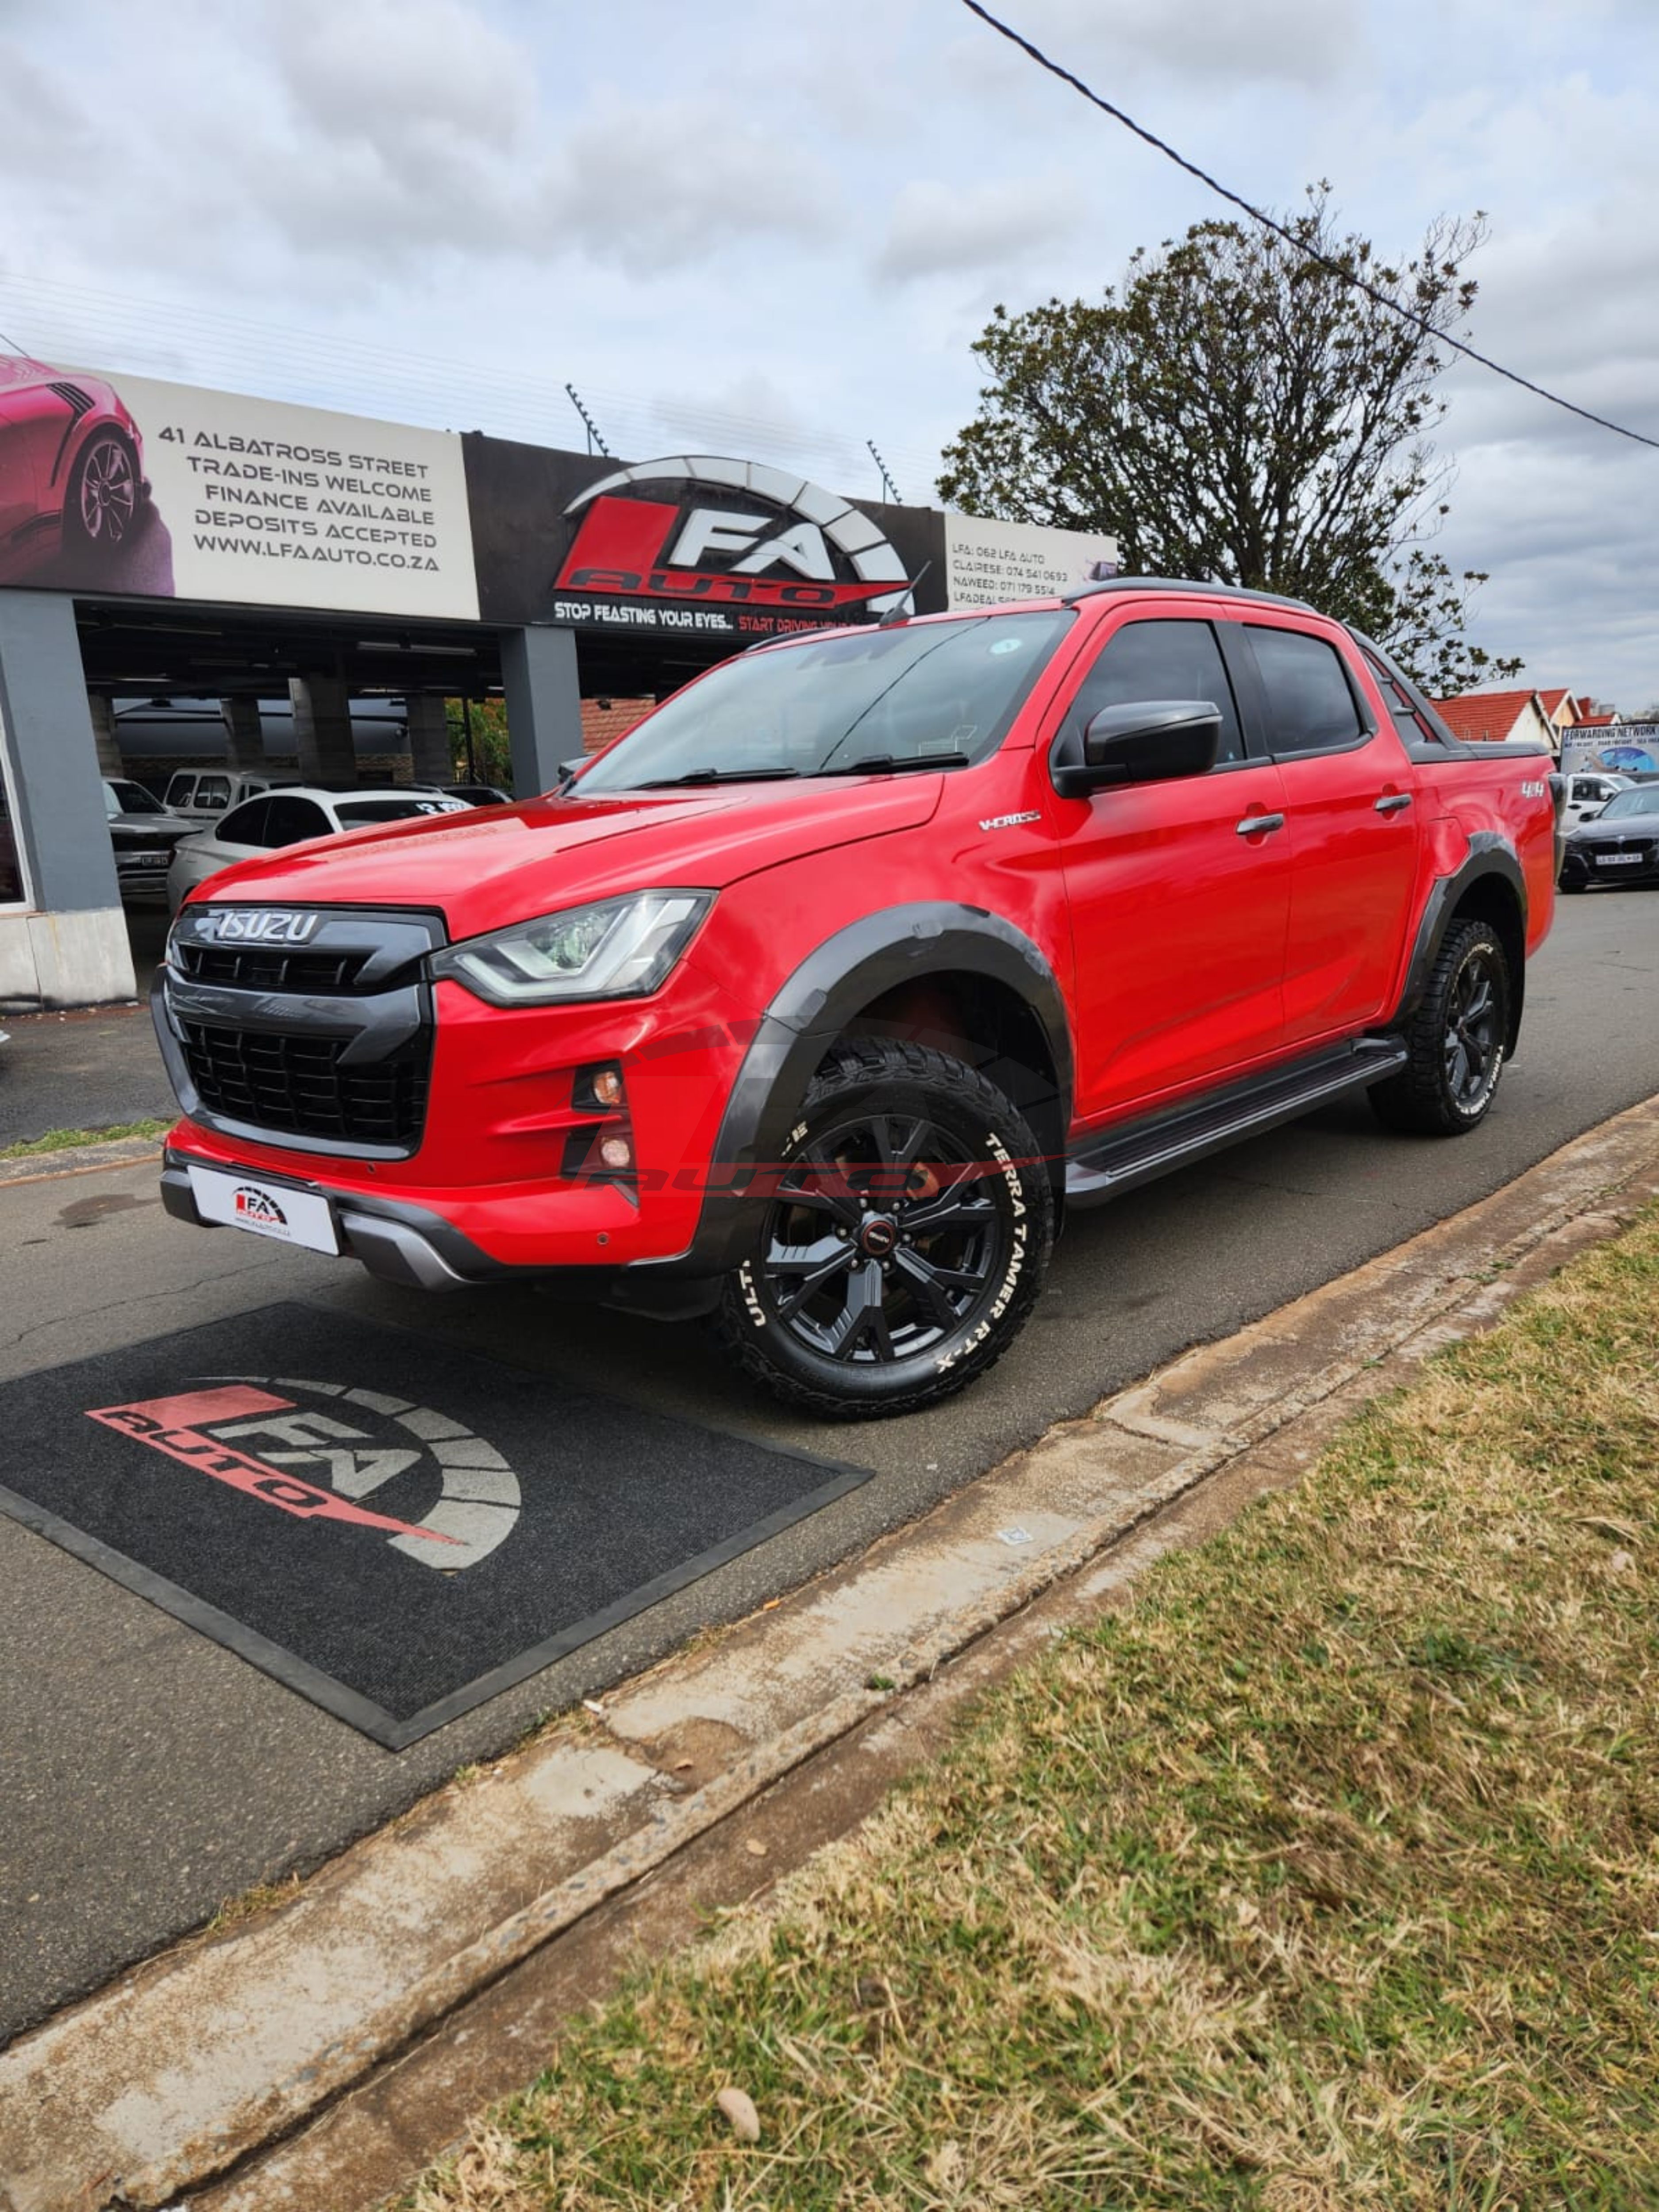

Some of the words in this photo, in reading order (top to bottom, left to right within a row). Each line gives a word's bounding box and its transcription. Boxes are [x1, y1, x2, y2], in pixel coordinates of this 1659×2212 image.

[158, 427, 185, 443] 41
[194, 431, 342, 466] ALBATROSS
[349, 455, 429, 479] STREET
[186, 456, 319, 488] TRADE-INS
[325, 475, 432, 502] WELCOME
[206, 485, 308, 511] FINANCE
[317, 499, 434, 525] AVAILABLE
[195, 509, 318, 536] DEPOSITS
[325, 524, 437, 548] ACCEPTED
[193, 535, 439, 572] WWW.LFAAUTO.CO.ZA
[1020, 553, 1045, 565] AUTO
[568, 568, 835, 604] AUTO
[554, 602, 591, 619] STOP
[593, 604, 656, 624] FEASTING
[658, 609, 693, 627] YOUR
[739, 616, 774, 631] START
[777, 619, 817, 633] DRIVING
[1617, 726, 1655, 737] NETWORK
[217, 913, 317, 941] ISUZU
[985, 1132, 1027, 1217] TERRA
[989, 1223, 1027, 1320] TAMER
[99, 1410, 328, 1508] AUTO
